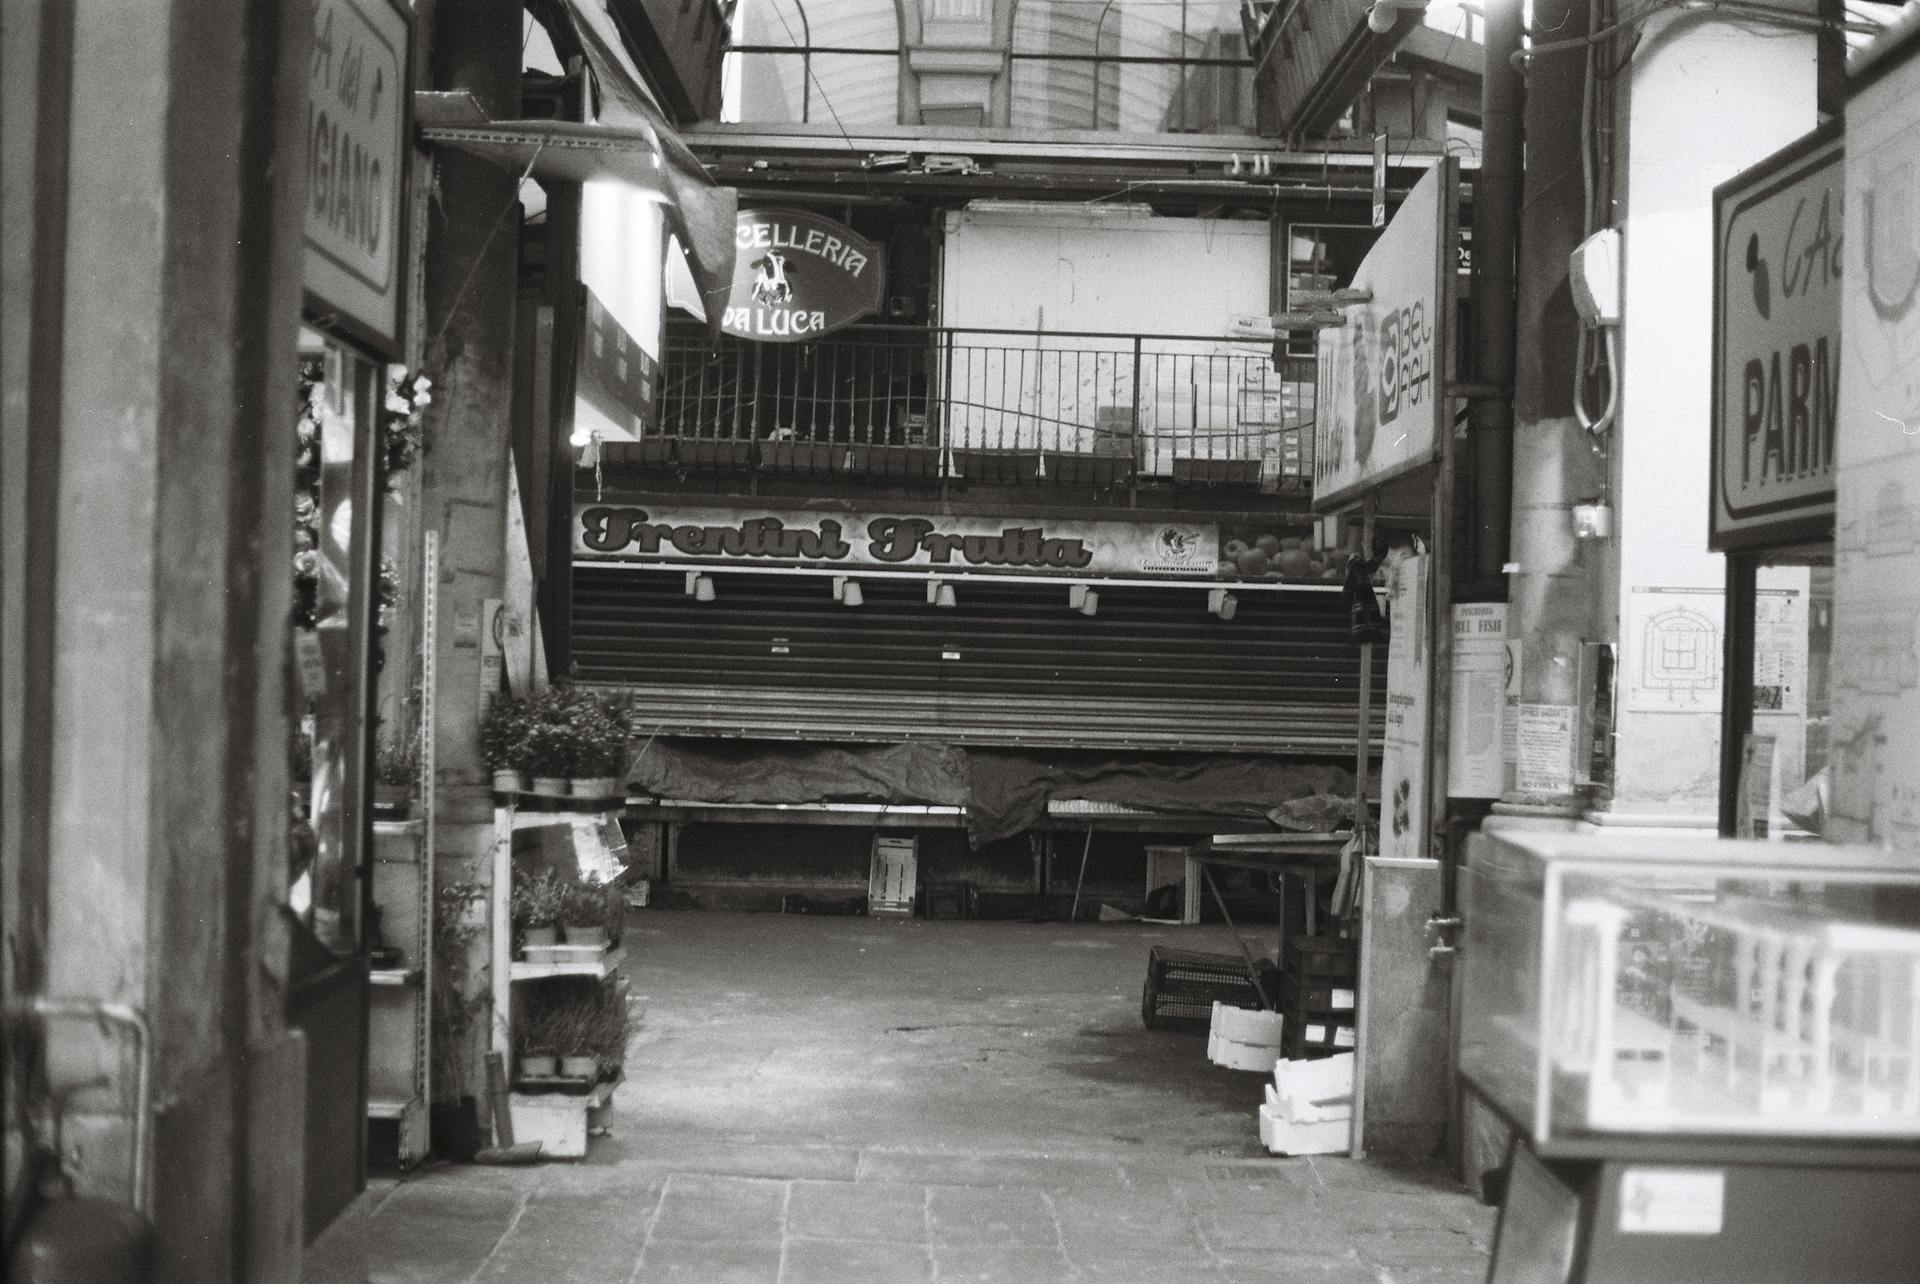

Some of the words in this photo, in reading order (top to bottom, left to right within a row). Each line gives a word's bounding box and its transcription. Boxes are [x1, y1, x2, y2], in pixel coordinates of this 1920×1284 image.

[756, 308, 825, 336] LUCA
[1401, 296, 1432, 359] BEL
[582, 506, 851, 560] Trentini
[867, 517, 1094, 568] Frutta
[1454, 619, 1472, 634] BEL
[1478, 618, 1502, 633] FISH
